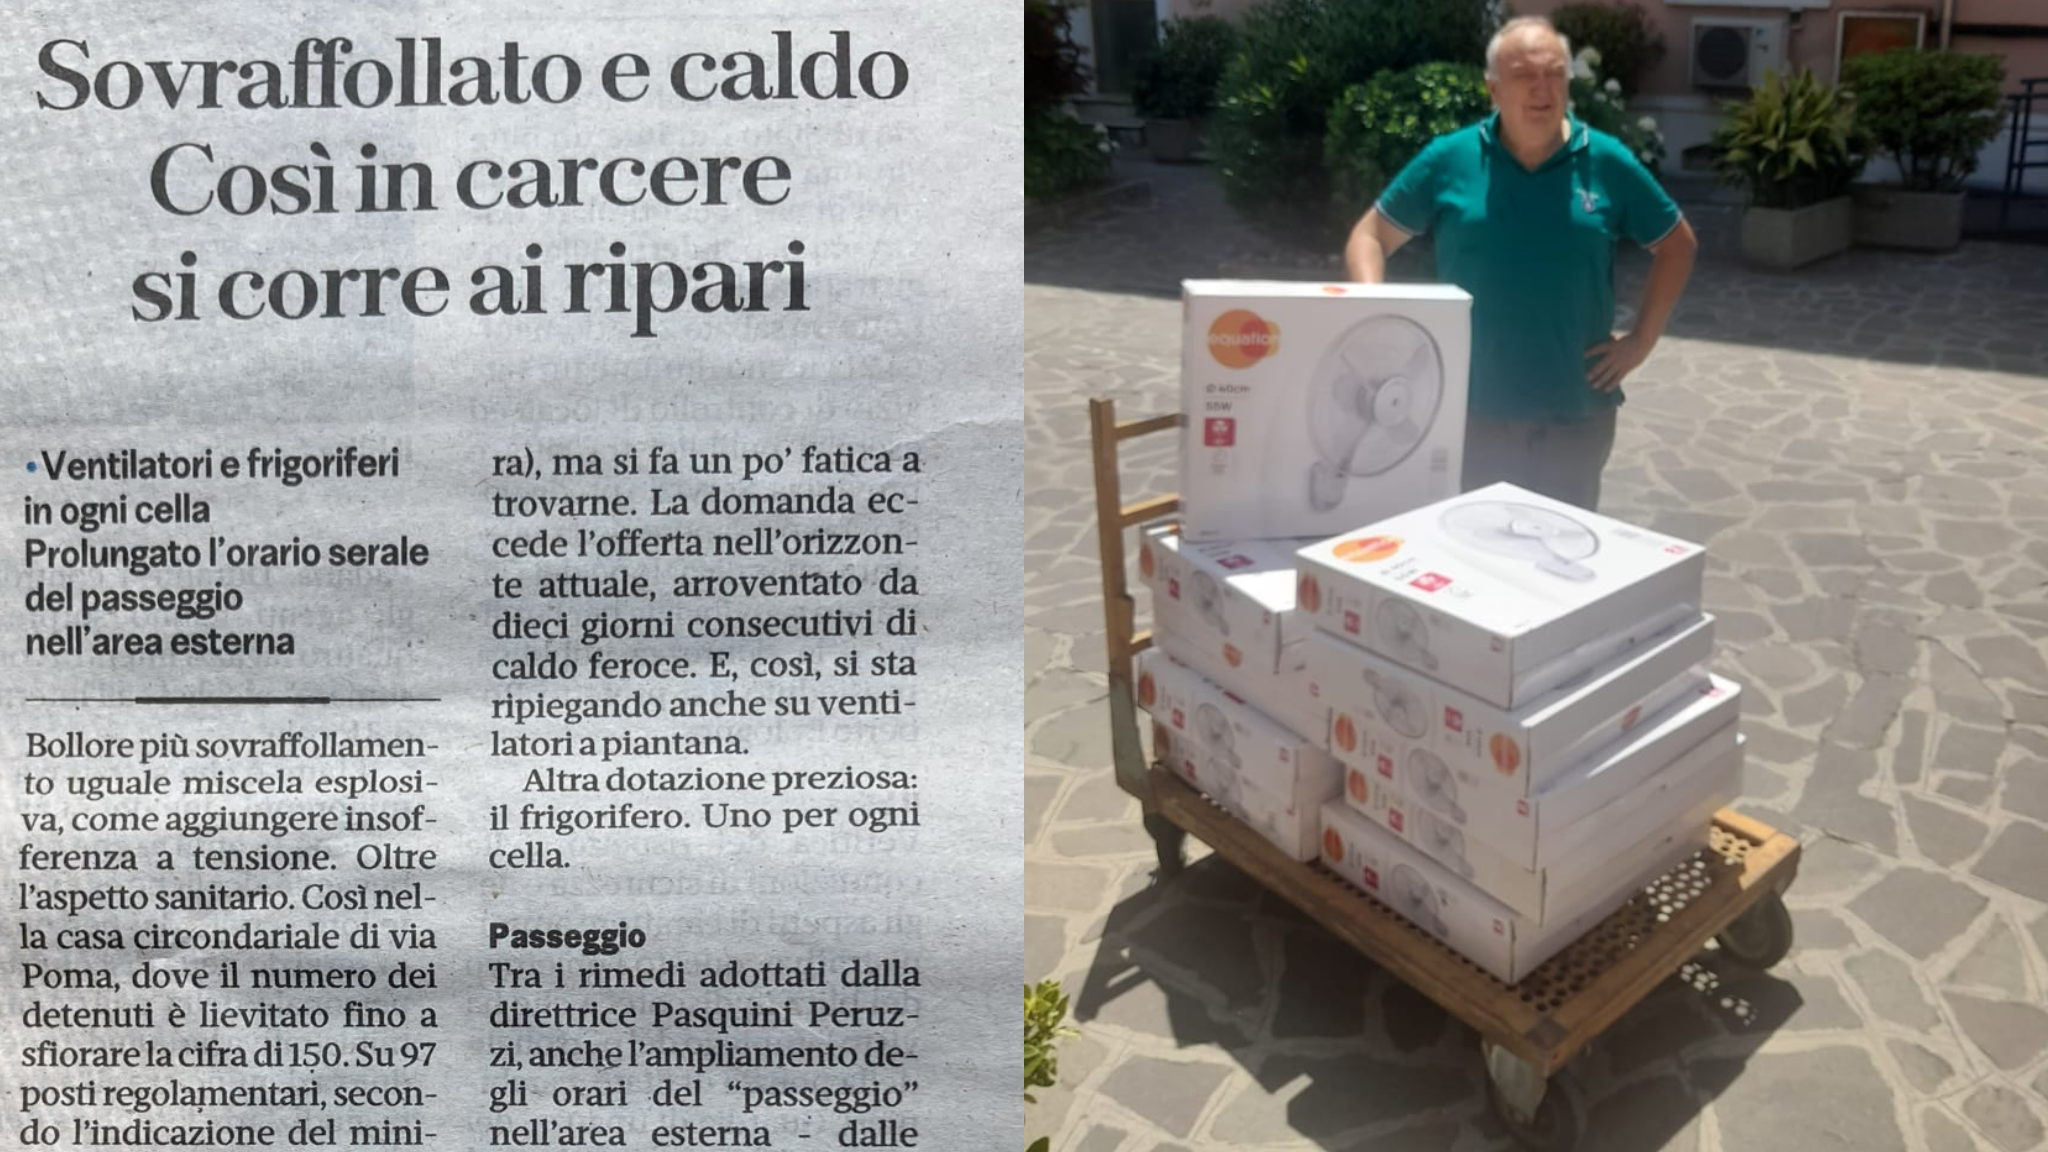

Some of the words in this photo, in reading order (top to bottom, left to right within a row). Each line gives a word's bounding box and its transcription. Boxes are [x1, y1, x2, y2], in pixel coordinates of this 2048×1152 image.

[35, 36, 583, 111] Sovraffollato
[601, 52, 651, 103] e
[670, 30, 909, 102] caldo
[149, 141, 339, 217] Così
[355, 142, 439, 213] in
[456, 155, 792, 210] carcere
[131, 250, 201, 323] si
[218, 266, 451, 321] corre
[469, 242, 548, 316] ai
[563, 239, 811, 338] ripari
[40, 448, 213, 481] Ventilatori
[220, 456, 241, 479] e
[246, 445, 400, 487] frigoriferi
[492, 446, 542, 481] ra),
[552, 453, 604, 476] ma
[613, 447, 639, 476] si
[648, 445, 680, 475] fa
[689, 453, 732, 474] un
[801, 444, 893, 474] fatica
[902, 451, 922, 474] a
[24, 495, 52, 525] in
[60, 493, 127, 533] ogni
[135, 492, 210, 524] cella
[491, 491, 637, 518] trovarne.
[650, 488, 690, 516] La
[701, 485, 856, 516] domanda
[867, 492, 919, 514] ec-
[25, 537, 201, 577] Prolungato
[328, 534, 430, 567] serale
[492, 529, 568, 558] cede
[713, 526, 918, 556] nell’orizzon-
[25, 581, 73, 613] del
[81, 580, 244, 621] passeggio
[491, 573, 523, 599] te
[538, 569, 656, 602] attuale,
[673, 570, 862, 597] arroventato
[879, 566, 920, 596] da
[170, 628, 295, 656] esterna
[492, 610, 569, 640] dieci
[580, 610, 675, 646] giorni
[687, 608, 873, 638] consecutivi
[886, 607, 918, 637] di
[492, 650, 578, 680] caldo
[588, 650, 697, 679] feroce.
[708, 651, 738, 682] E,
[750, 651, 822, 681] così,
[833, 649, 860, 677] si
[870, 650, 918, 677] sta
[491, 690, 662, 725] ripiegando
[669, 689, 767, 717] anche
[774, 695, 811, 717] su
[817, 689, 916, 716] venti-
[25, 731, 135, 759] Bollore
[139, 732, 190, 765] più
[195, 731, 439, 759] sovraffollamen-
[490, 730, 574, 757] latori
[579, 736, 597, 756] a
[601, 730, 749, 762] piantana.
[23, 772, 55, 796] to
[66, 769, 171, 801] uguale
[183, 769, 303, 795] miscela
[315, 768, 438, 800] esplosi-
[522, 767, 600, 793] Altra
[605, 766, 766, 792] dotazione
[771, 765, 918, 797] preziosa:
[20, 812, 64, 836] va,
[71, 812, 159, 832] come
[165, 806, 339, 838] aggiungere
[344, 804, 437, 832] insof-
[489, 803, 509, 831] il
[519, 802, 691, 836] frigorifero.
[701, 803, 772, 829] Uno
[782, 807, 838, 834] per
[848, 800, 921, 834] ogni
[18, 842, 139, 871] ferenza
[156, 850, 175, 871] a
[192, 843, 337, 871] tensione.
[356, 842, 437, 870] Oltre
[488, 841, 571, 870] cella.
[155, 883, 295, 911] sanitario.
[302, 883, 368, 911] Così
[373, 881, 437, 910] nel-
[18, 921, 49, 950] la
[56, 929, 126, 950] casa
[133, 921, 340, 951] circondariale
[349, 921, 380, 950] di
[388, 923, 438, 950] via
[489, 920, 647, 956] Passeggio
[21, 962, 121, 993] Poma,
[132, 961, 210, 989] dove
[219, 960, 240, 989] il
[250, 968, 377, 989] numero
[387, 961, 438, 989] dei
[488, 961, 543, 989] Tra
[554, 961, 565, 989] i
[578, 960, 687, 989] rimedi
[699, 959, 827, 988] adottati
[840, 958, 922, 988] dalla
[22, 1000, 155, 1029] detenuti
[168, 1001, 186, 1029] è
[199, 1000, 329, 1028] lievitato
[343, 1000, 406, 1028] fino
[420, 1007, 439, 1028] a
[489, 1000, 637, 1029] direttrice
[651, 1000, 794, 1035] Pasquini
[808, 1001, 920, 1028] Peruz-
[21, 1039, 141, 1068] sfiorare
[145, 1039, 174, 1068] la
[178, 1039, 249, 1068] cifra
[253, 1039, 284, 1068] di
[288, 1042, 349, 1068] 150.
[355, 1040, 395, 1068] Su
[400, 1041, 437, 1068] 97
[489, 1040, 523, 1071] zi,
[529, 1039, 623, 1069] anche
[864, 1039, 919, 1068] de-
[19, 1080, 97, 1113] posti
[102, 1078, 327, 1114] regolamentari,
[333, 1086, 438, 1107] secon-
[488, 1078, 528, 1114] gli
[552, 1080, 628, 1107] orari
[652, 1078, 703, 1107] del
[19, 1117, 60, 1146] do
[288, 1118, 337, 1146] del
[349, 1119, 437, 1146] mini-
[651, 1122, 772, 1147] esterna
[838, 1119, 919, 1148] dalle
